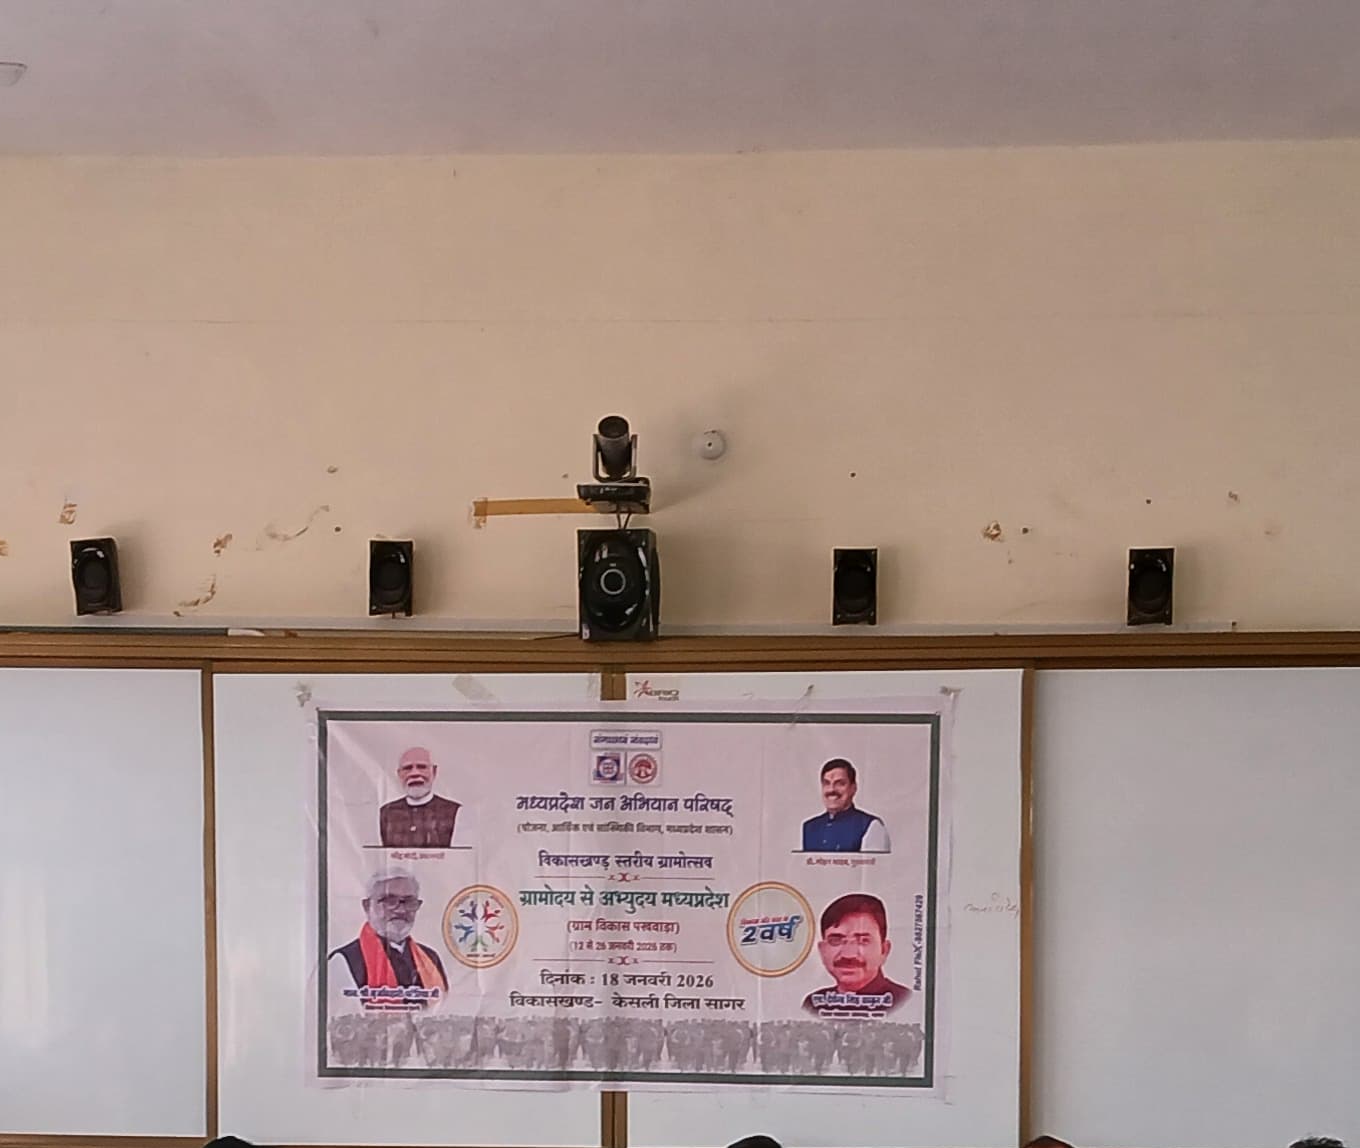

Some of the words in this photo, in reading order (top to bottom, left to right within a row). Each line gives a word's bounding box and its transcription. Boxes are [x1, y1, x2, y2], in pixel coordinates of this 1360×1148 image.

[516, 791, 585, 813] मध्यप्रदेश
[589, 797, 616, 811] जन
[620, 792, 679, 812] अभियान
[614, 850, 654, 869] स्तरीय
[657, 851, 713, 870] ग्रामोत्सव
[519, 884, 577, 907] ग्रामोदय
[580, 884, 595, 907] से
[599, 890, 657, 914] अभ्युदय
[661, 885, 730, 909] मध्यप्रदेश
[595, 918, 630, 932] विकास
[742, 925, 756, 943] 2
[758, 915, 801, 941] वर्ष
[540, 967, 586, 985] दिनांक
[601, 973, 619, 986] 18
[623, 970, 671, 986] जनवरी
[676, 974, 714, 988] 2026
[611, 992, 660, 1009] केसली
[664, 992, 701, 1010] जिला
[704, 998, 746, 1011] सागर
